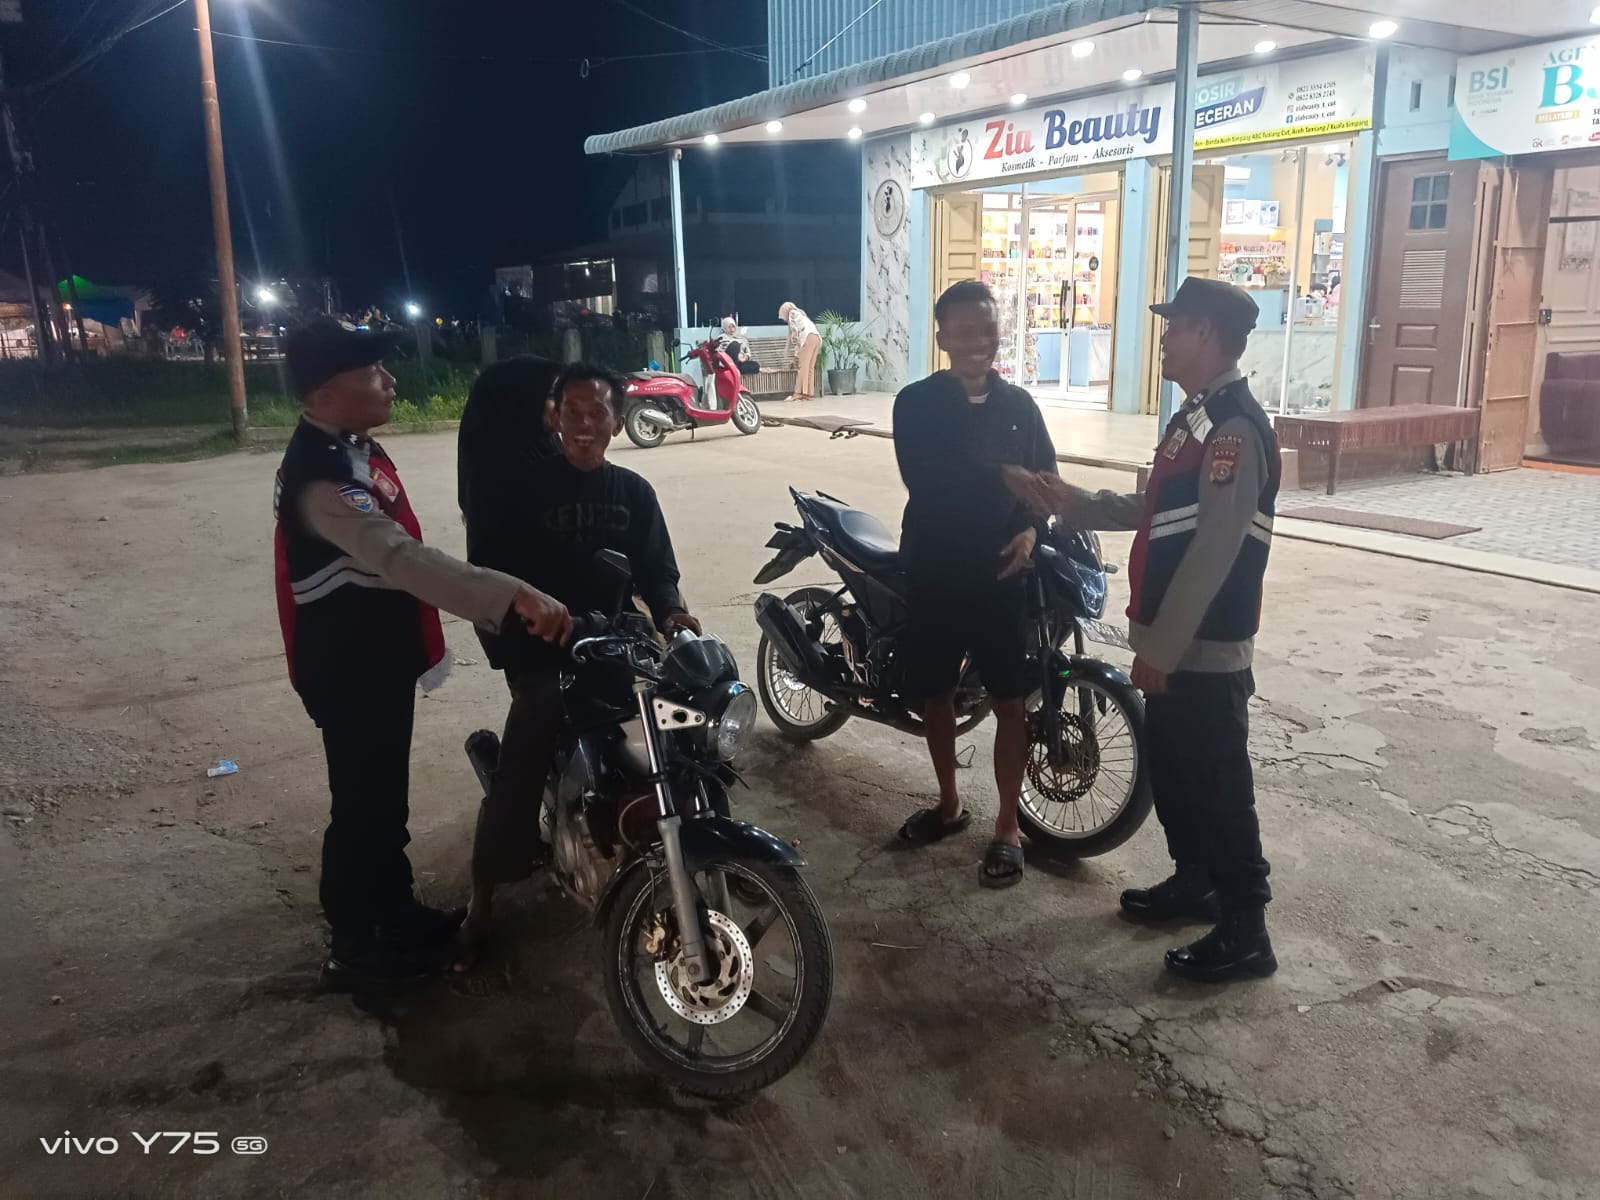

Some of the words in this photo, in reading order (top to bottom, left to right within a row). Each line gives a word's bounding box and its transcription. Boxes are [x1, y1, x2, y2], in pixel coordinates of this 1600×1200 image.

[1469, 66, 1509, 93] BSI
[1195, 82, 1235, 106] OSIR
[1196, 98, 1254, 126] ECERAN
[1346, 120, 1369, 128] Simpang
[984, 120, 1034, 160] Zia
[1044, 103, 1162, 150] Beauty
[1001, 158, 1036, 172] Kosmetik
[1048, 152, 1079, 168] Parfum
[1092, 144, 1134, 160] Aksesoris
